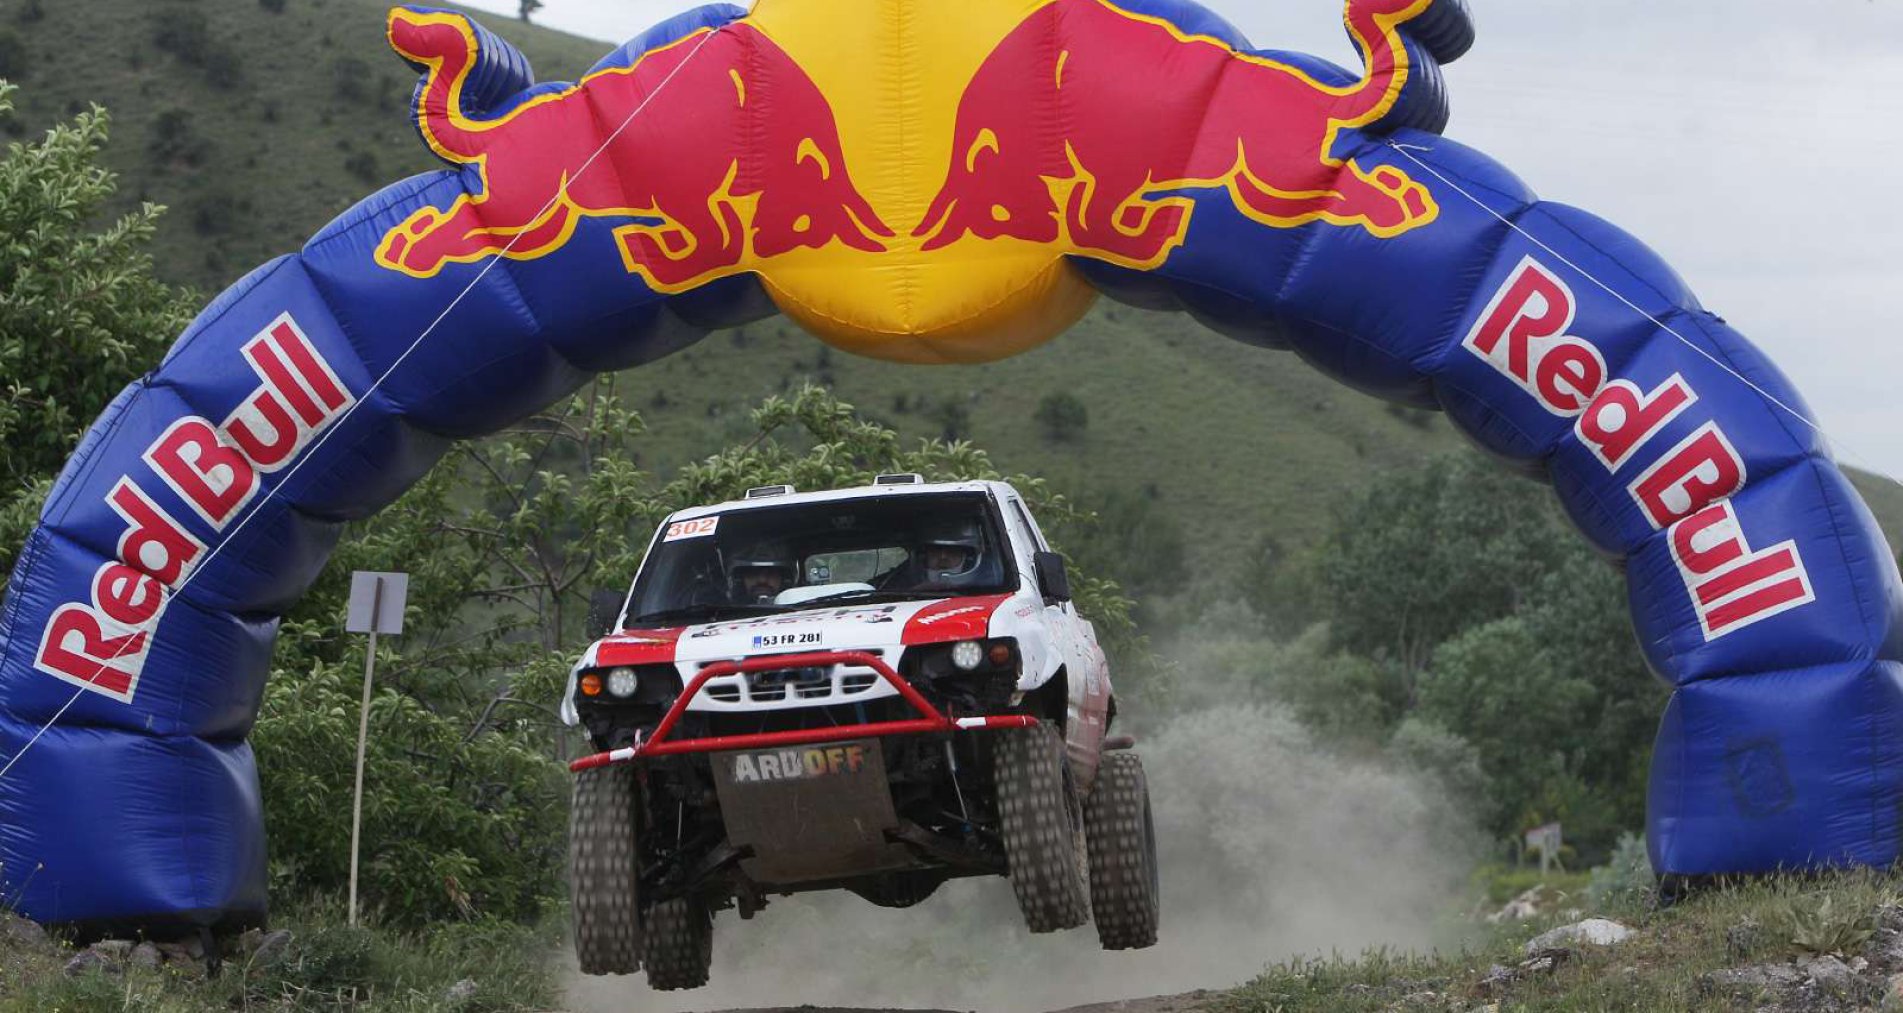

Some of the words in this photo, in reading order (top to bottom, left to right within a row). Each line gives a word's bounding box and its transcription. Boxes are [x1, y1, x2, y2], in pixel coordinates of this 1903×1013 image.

[35, 476, 207, 702] Red
[143, 312, 356, 533] Bull
[666, 519, 715, 537] 302
[1463, 255, 1697, 473] Red
[1627, 421, 1814, 640] Bull
[763, 635, 777, 646] 53
[781, 633, 795, 644] FR
[799, 632, 820, 643] 281
